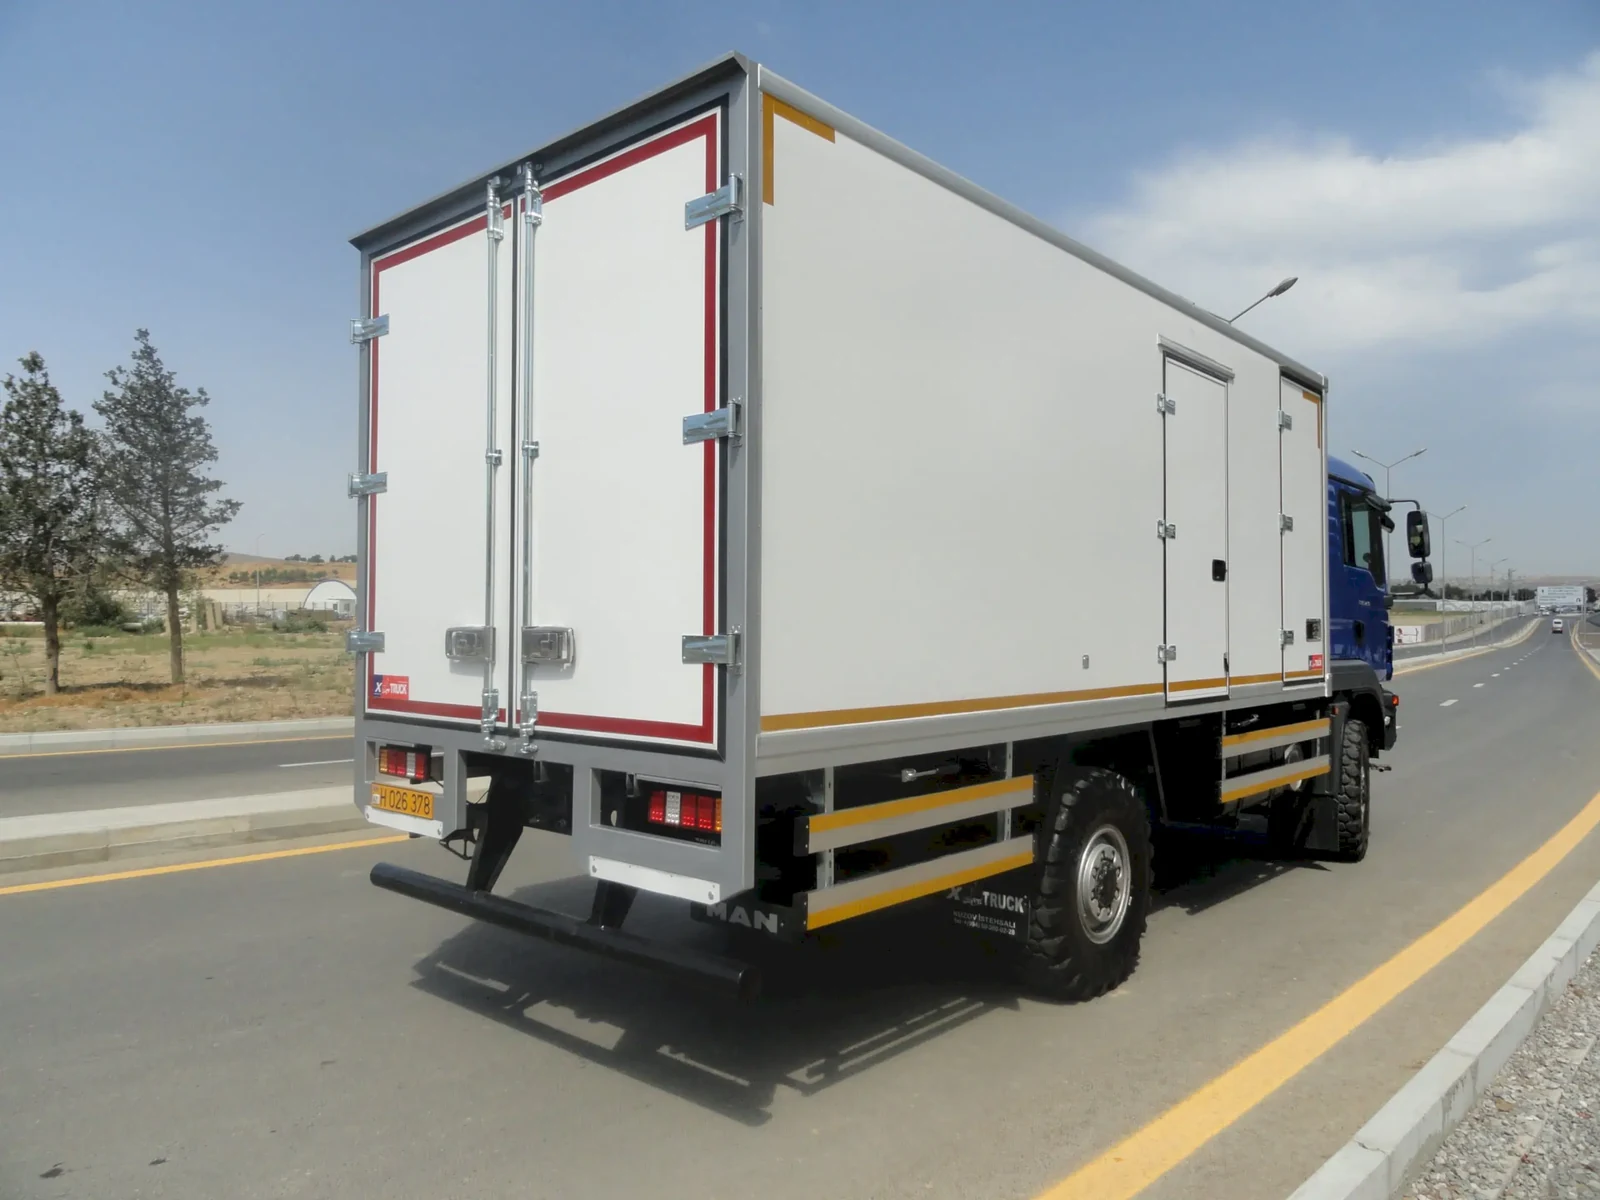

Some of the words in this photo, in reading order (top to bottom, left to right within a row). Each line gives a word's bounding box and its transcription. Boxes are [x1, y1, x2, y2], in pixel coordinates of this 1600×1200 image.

[374, 681, 383, 693] X
[389, 790, 408, 811] 026
[411, 793, 430, 815] 378
[982, 890, 1025, 914] TRUCK
[706, 902, 778, 934] MAN
